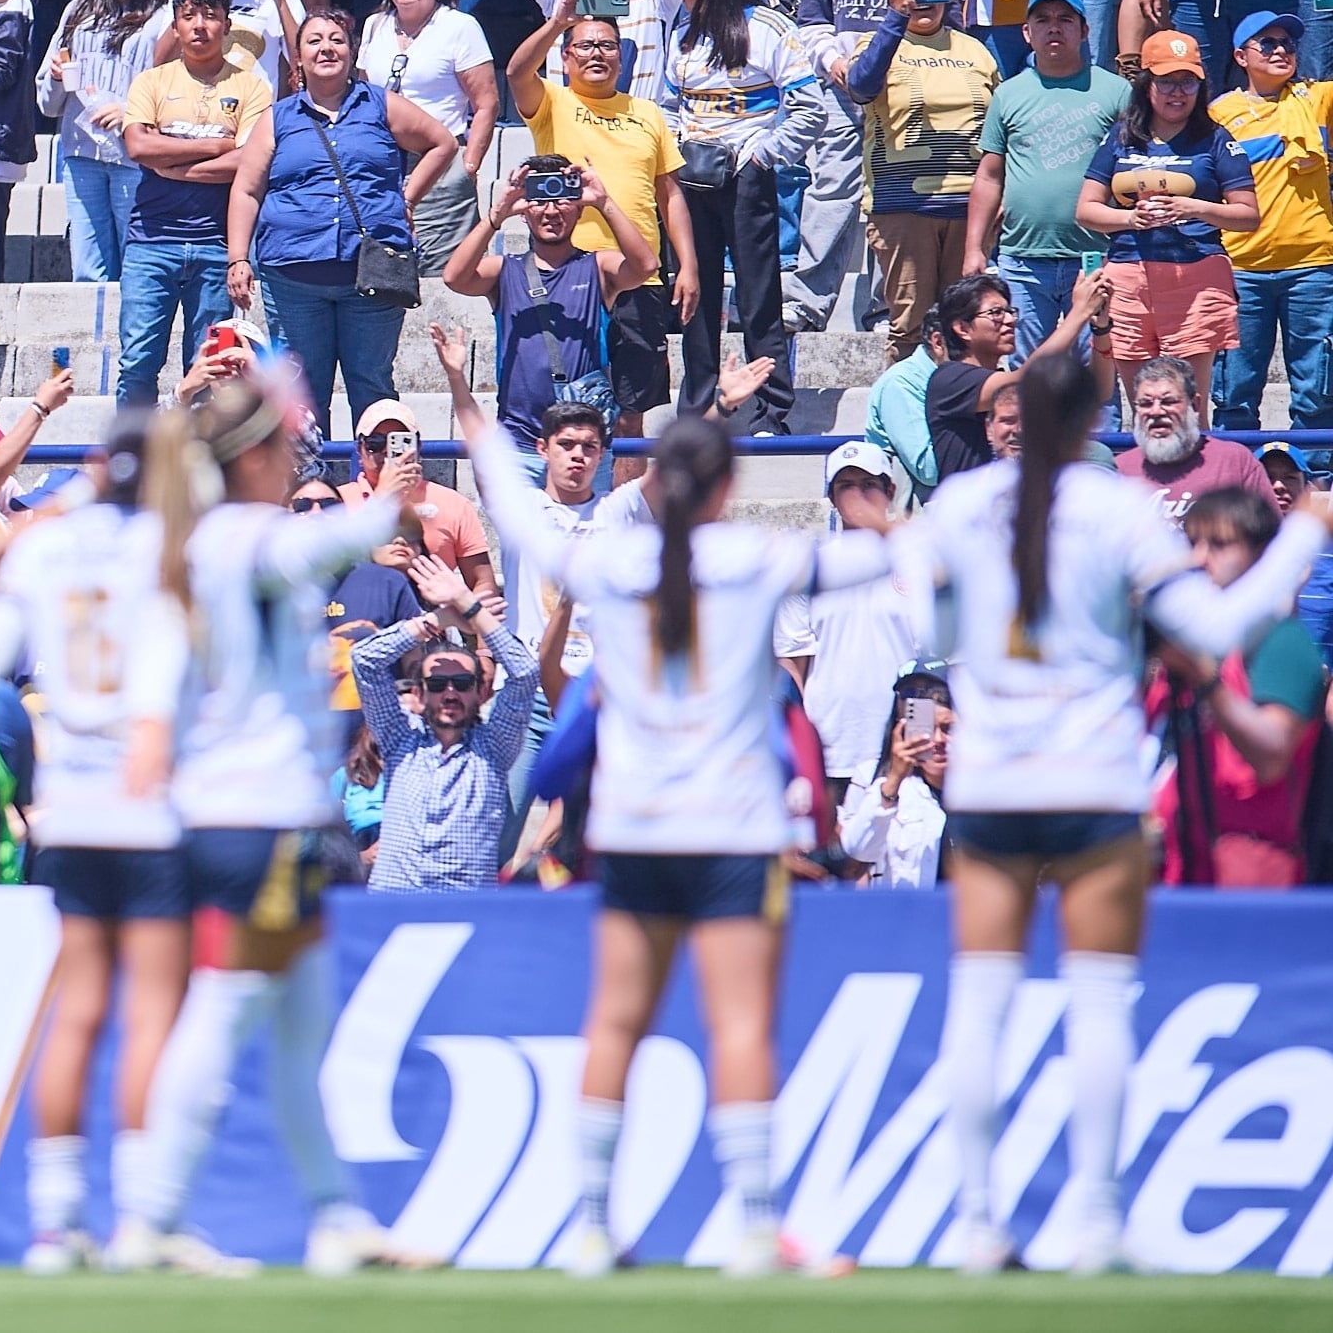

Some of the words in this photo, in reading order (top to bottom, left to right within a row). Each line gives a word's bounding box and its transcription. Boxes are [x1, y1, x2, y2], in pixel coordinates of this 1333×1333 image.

[1032, 102, 1061, 126] non
[1038, 125, 1088, 157] action
[1041, 137, 1094, 170] league
